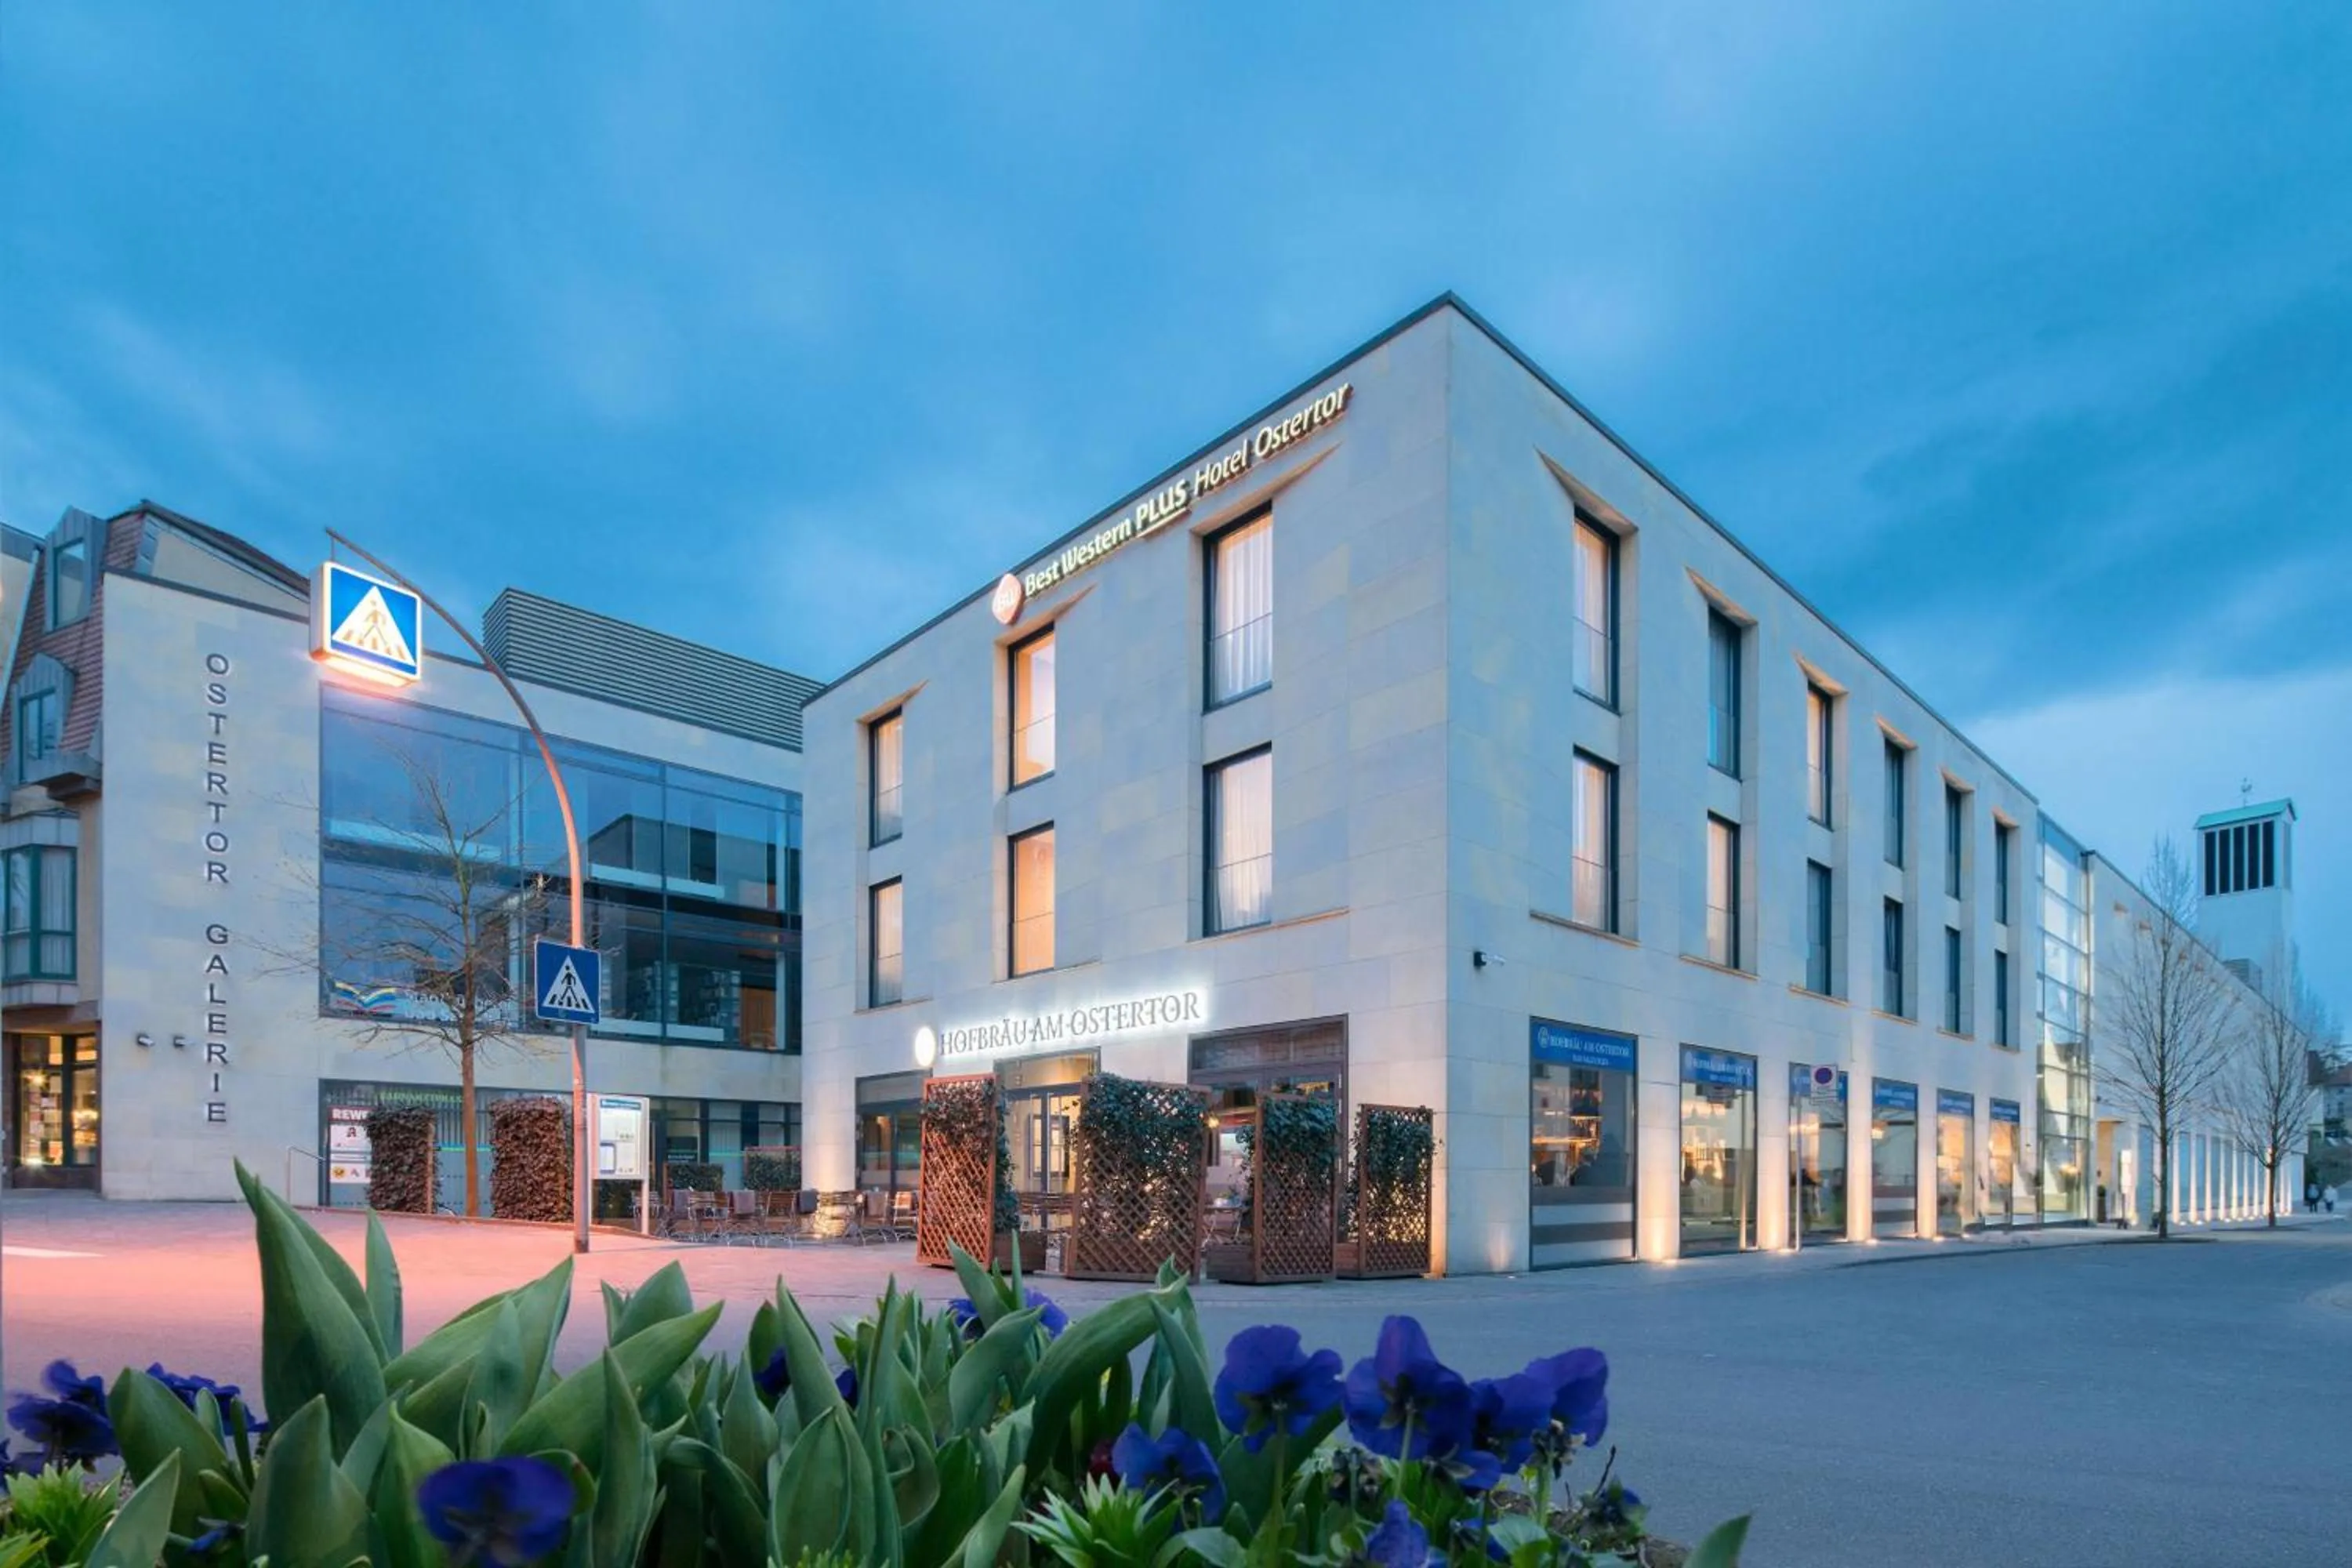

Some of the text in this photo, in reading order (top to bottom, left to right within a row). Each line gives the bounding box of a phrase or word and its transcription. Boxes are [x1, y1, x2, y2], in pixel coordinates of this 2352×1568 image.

[1025, 561, 1060, 597] Best
[1062, 517, 1131, 576] Western
[1135, 477, 1187, 532] PLUS
[1193, 439, 1247, 497] Hotel
[1254, 382, 1352, 458] Ostertor
[205, 652, 229, 1123] OSTERTOR GALERIE
[941, 992, 1200, 1055] HOFBRÄU AM OSTERTOR
